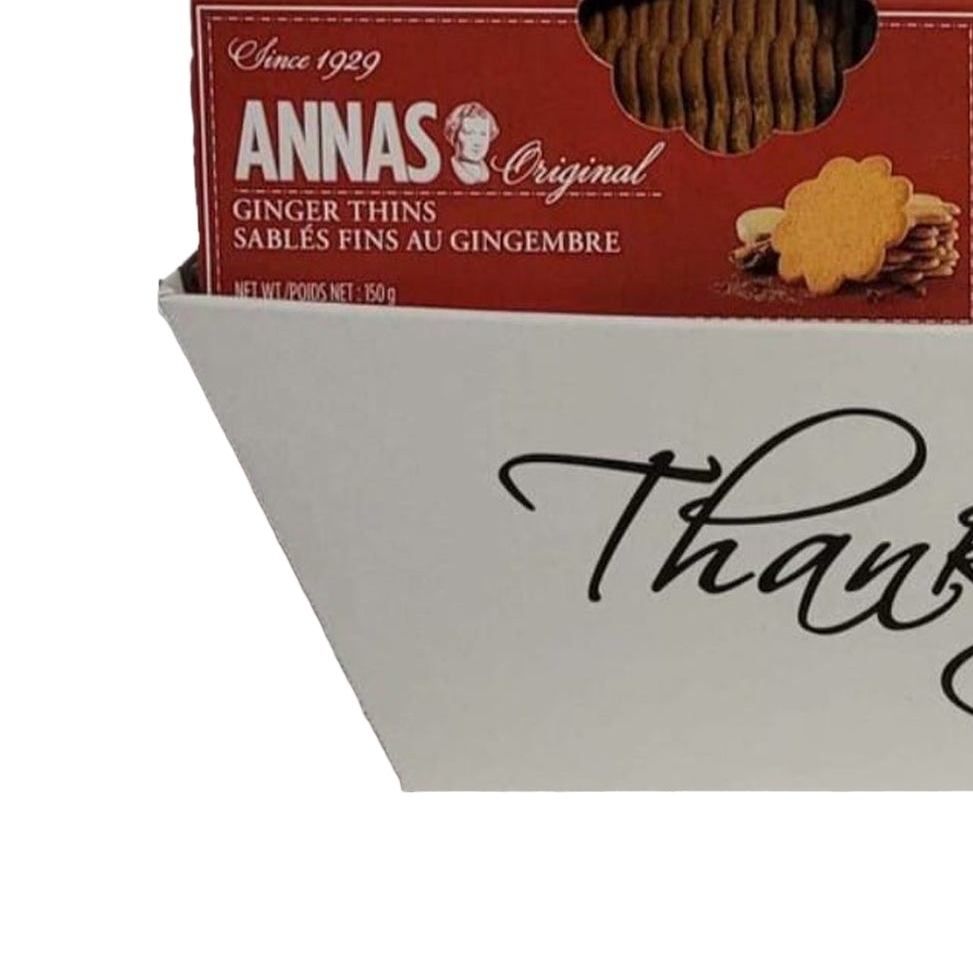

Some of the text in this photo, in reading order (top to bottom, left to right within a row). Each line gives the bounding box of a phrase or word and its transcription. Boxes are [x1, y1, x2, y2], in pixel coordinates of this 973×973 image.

[228, 36, 381, 81] Since 1929
[234, 99, 666, 205] ANNAS Original
[233, 199, 437, 223] GINGER THINS
[233, 223, 621, 254] SABLÉS FINS AU GINGEMBRE
[234, 280, 258, 297] NET
[330, 282, 353, 302] NET
[364, 283, 386, 303] 150
[387, 287, 396, 306] g
